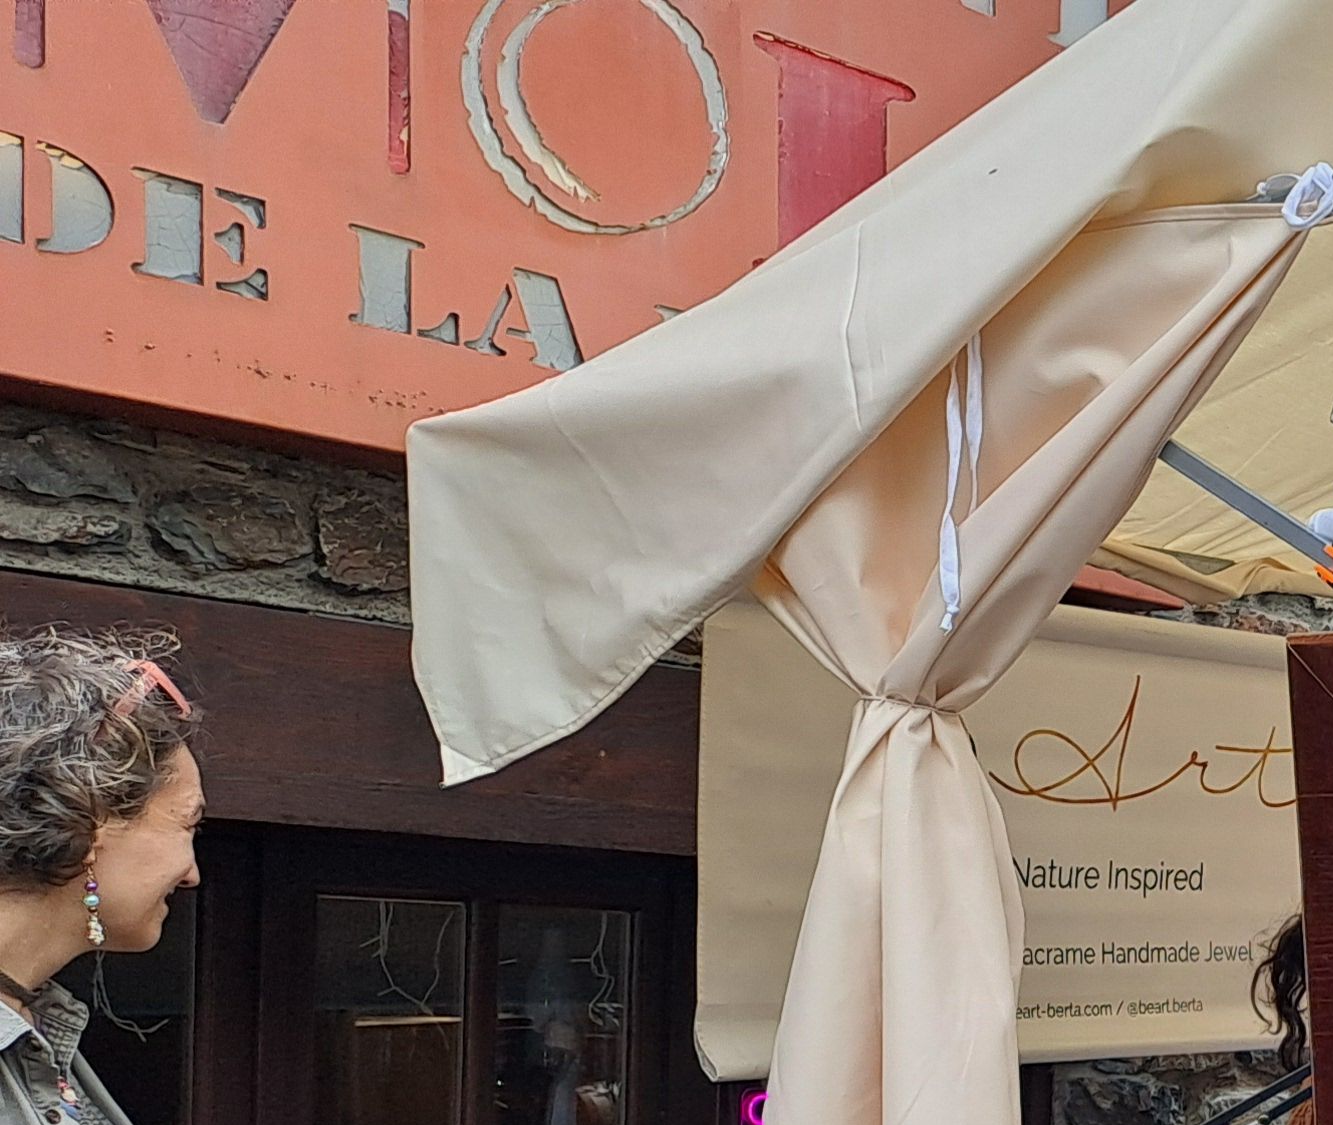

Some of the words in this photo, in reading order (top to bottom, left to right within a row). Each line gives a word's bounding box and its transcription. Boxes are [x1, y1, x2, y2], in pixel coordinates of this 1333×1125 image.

[0, 131, 268, 300] DE
[348, 222, 585, 371] LA
[988, 675, 1295, 812] Art
[1012, 857, 1100, 889] Nature
[1107, 859, 1204, 898] Inspired
[1023, 946, 1096, 965] acrame
[1101, 940, 1200, 964] Handmade
[1203, 940, 1253, 962] Jewel
[1016, 1001, 1113, 1019] eart-berta.com
